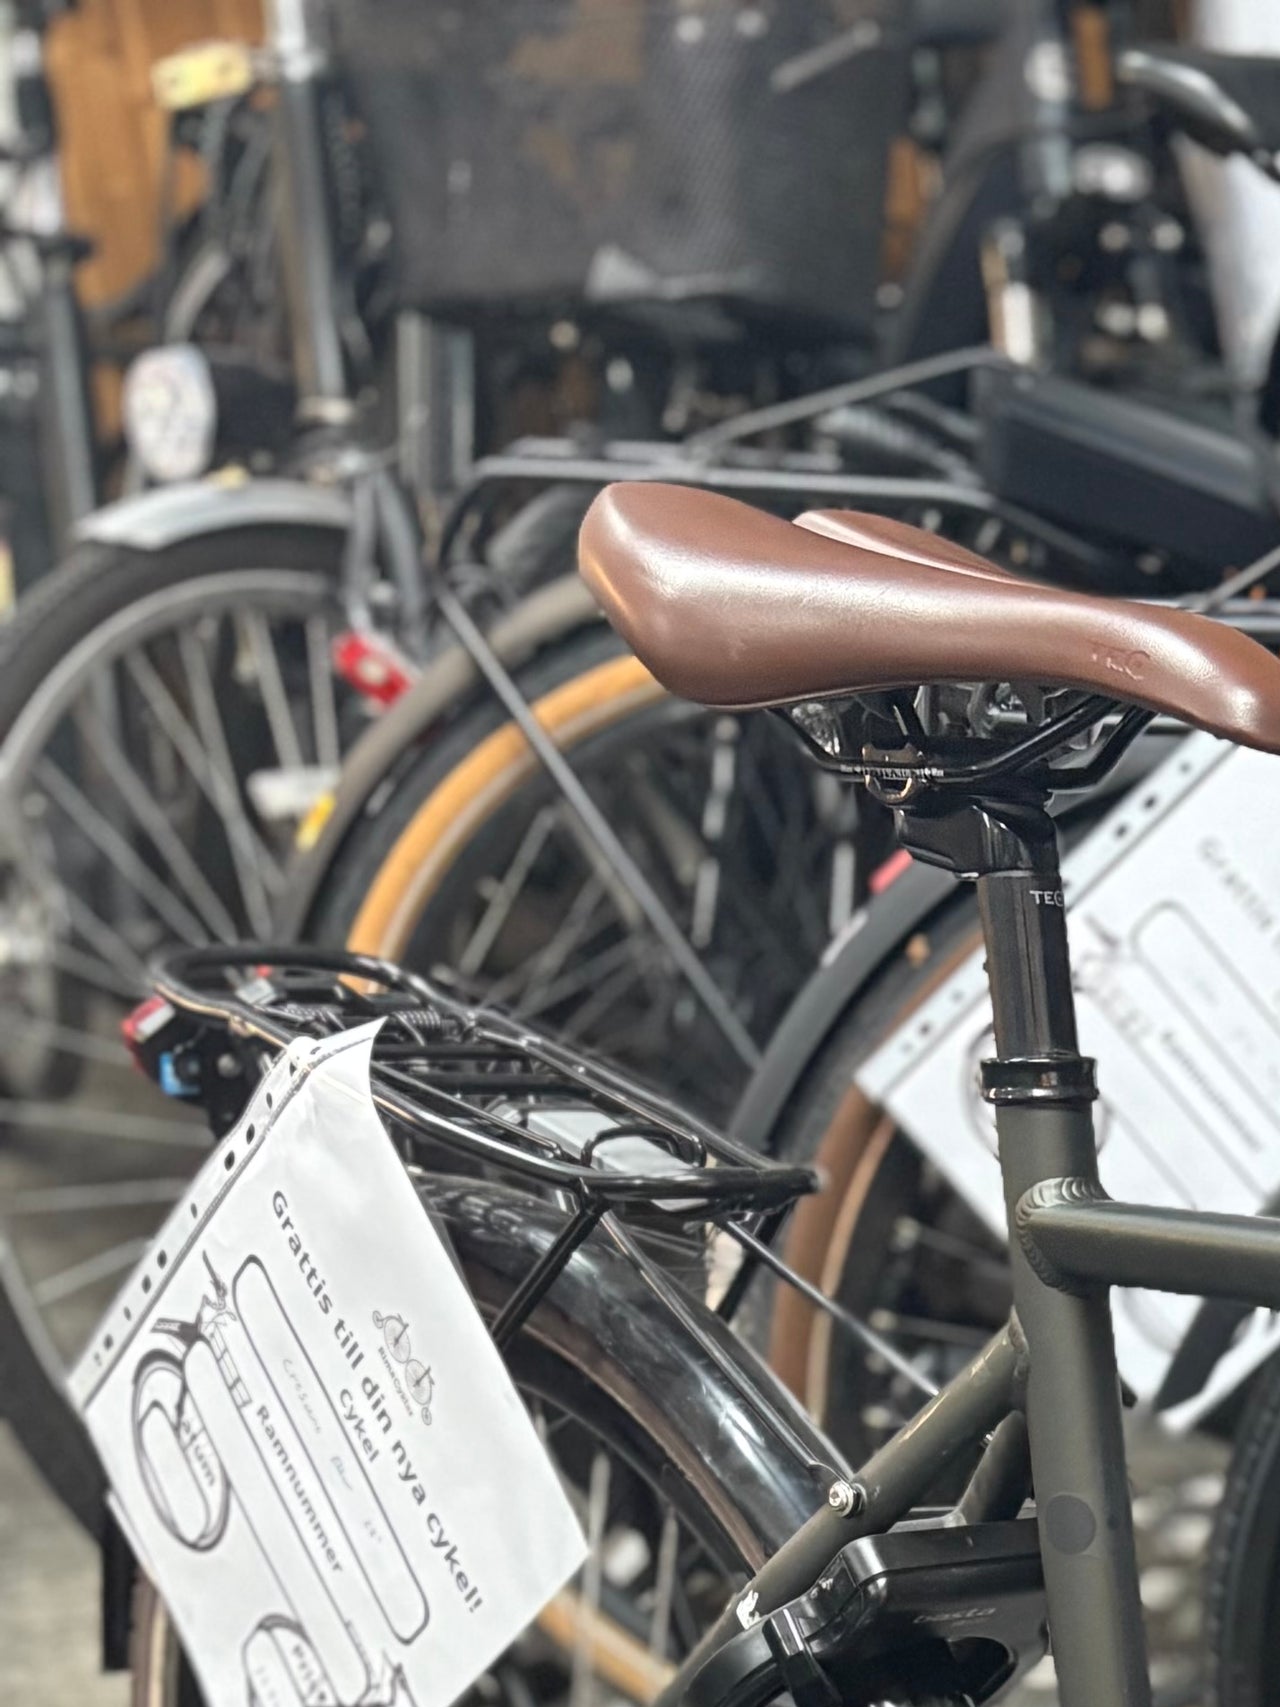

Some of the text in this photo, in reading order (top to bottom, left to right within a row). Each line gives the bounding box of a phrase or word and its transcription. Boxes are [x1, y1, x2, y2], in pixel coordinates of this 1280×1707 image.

[271, 1189, 486, 1615] Grattis till din nya cykel!
[338, 1387, 380, 1464] Cykel
[255, 1403, 346, 1575] Ramnummer
